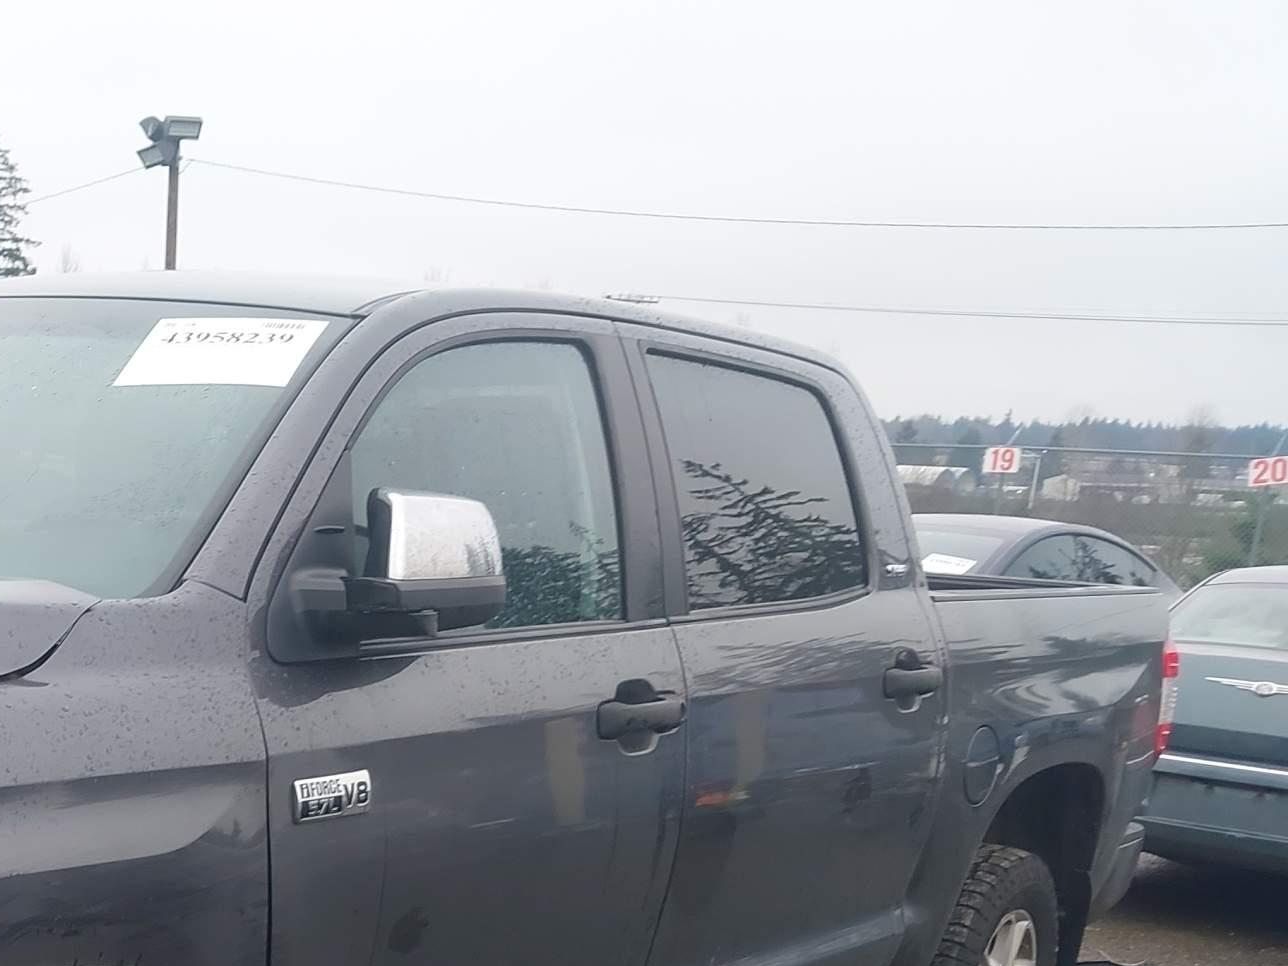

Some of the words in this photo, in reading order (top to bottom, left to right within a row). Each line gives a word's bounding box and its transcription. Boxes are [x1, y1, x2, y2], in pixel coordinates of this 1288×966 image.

[161, 331, 295, 345] 43958239
[991, 448, 1015, 471] 19
[1253, 458, 1288, 485] 20
[343, 780, 368, 807] V8
